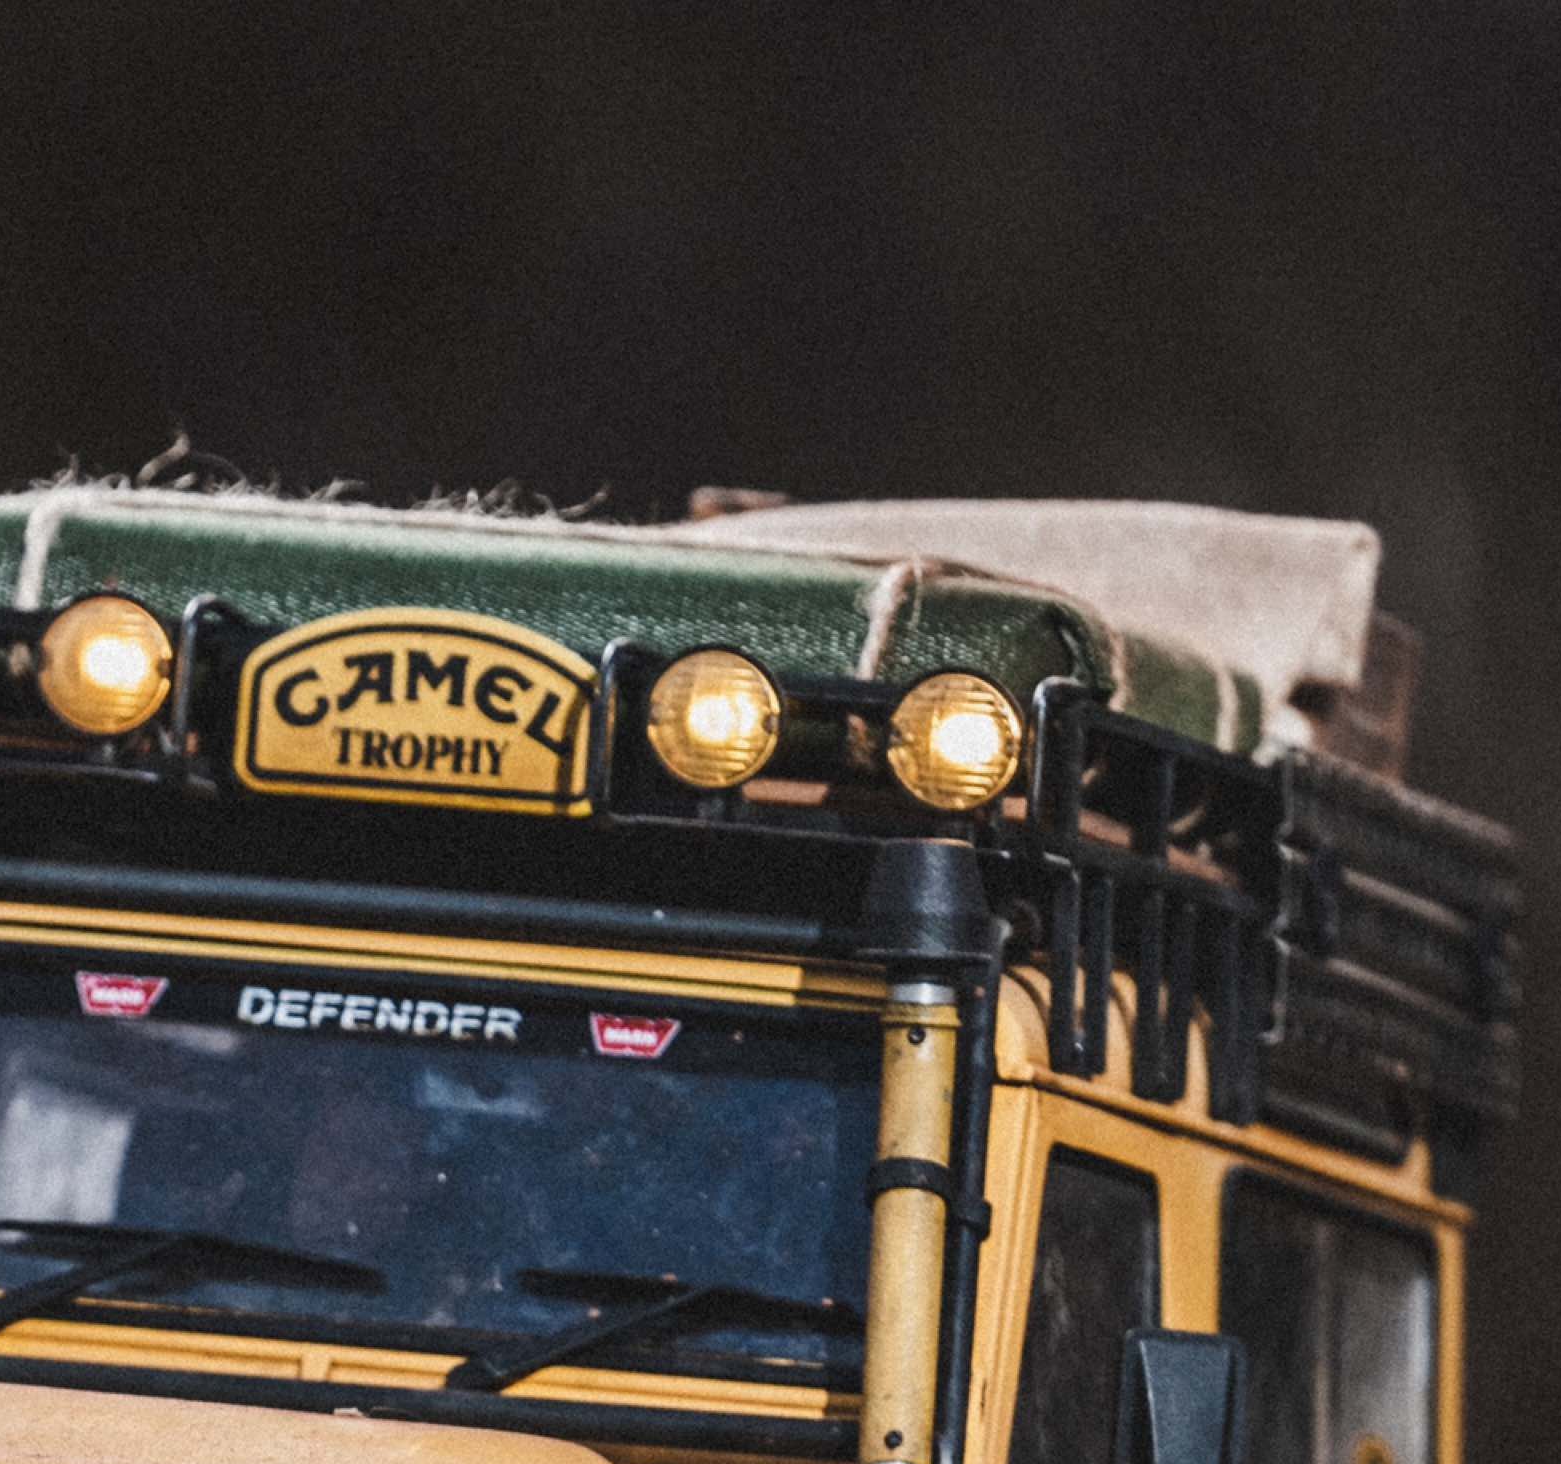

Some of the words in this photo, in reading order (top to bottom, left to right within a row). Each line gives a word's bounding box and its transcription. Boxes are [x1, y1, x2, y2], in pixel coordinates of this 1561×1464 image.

[274, 649, 572, 757] CAMEL
[334, 726, 509, 776] TROPHY
[237, 985, 523, 1041] DEFENDER
